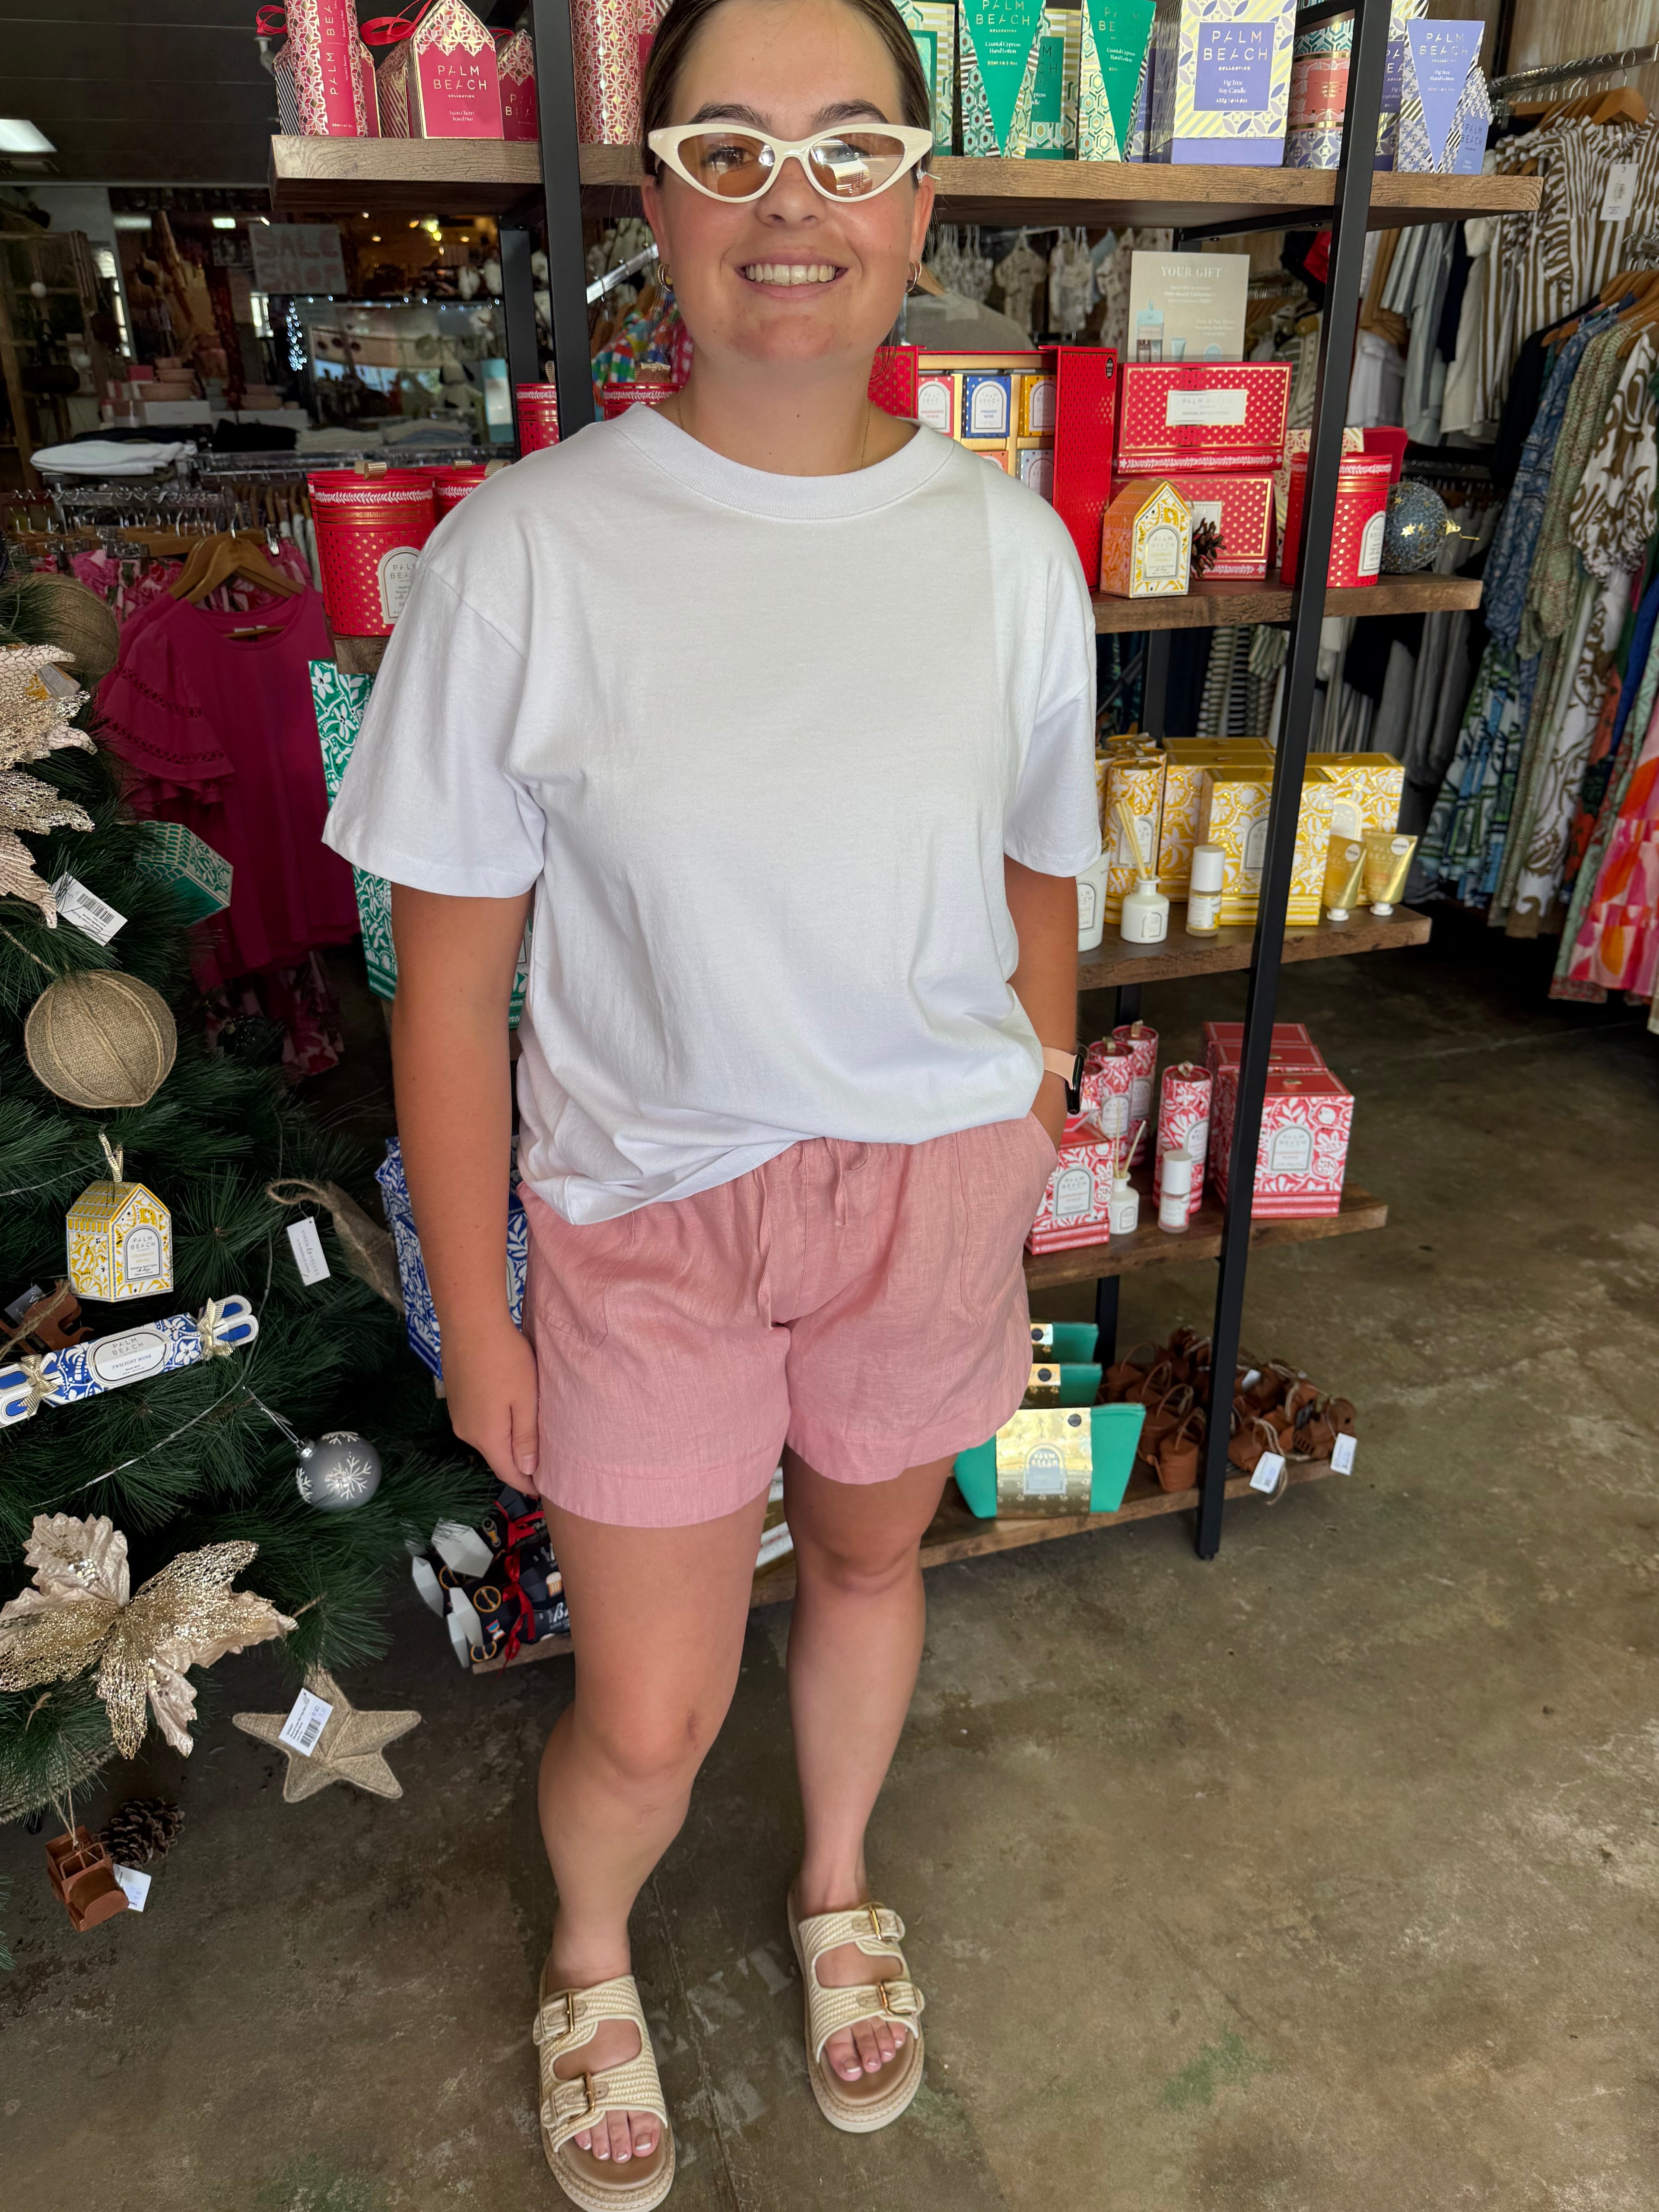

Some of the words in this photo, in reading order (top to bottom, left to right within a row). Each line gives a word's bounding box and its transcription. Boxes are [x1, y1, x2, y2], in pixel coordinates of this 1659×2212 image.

[983, 0, 1024, 10] PALM
[976, 14, 1030, 26] BEACH
[1212, 31, 1262, 43] PALM
[1426, 33, 1464, 42] PALM
[1204, 48, 1267, 60] BEACH
[1419, 45, 1468, 55] BEACH
[326, 52, 339, 95] PALM
[438, 65, 480, 76] PALM
[433, 79, 487, 90] BEACH
[510, 94, 536, 105] PAL
[1465, 124, 1483, 134] PALM
[1461, 134, 1482, 145] BEACH
[255, 228, 339, 258] SALE
[258, 261, 341, 292] SHOP
[1161, 266, 1192, 277] YOUR
[1195, 267, 1222, 278] GIFT
[1373, 844, 1391, 854] PAL
[112, 1338, 138, 1348] PALM
[112, 1342, 143, 1356] BEACH
[112, 1358, 137, 1370] TWILIGHT
